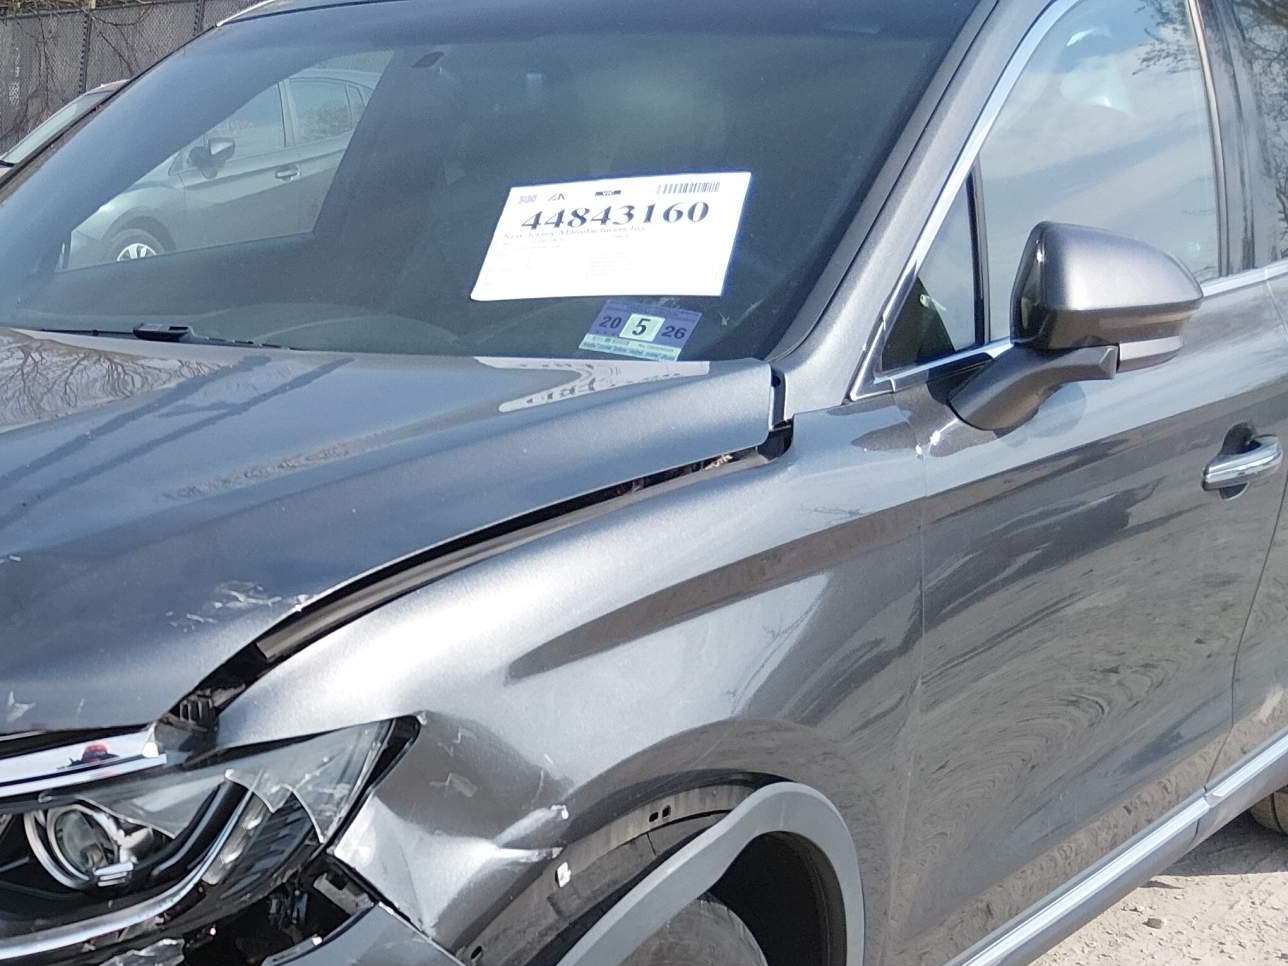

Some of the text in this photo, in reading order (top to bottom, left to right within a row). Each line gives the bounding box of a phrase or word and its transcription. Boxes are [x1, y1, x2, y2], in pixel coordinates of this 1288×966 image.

[520, 200, 710, 231] 44843160
[598, 315, 687, 340] 20 5 26
